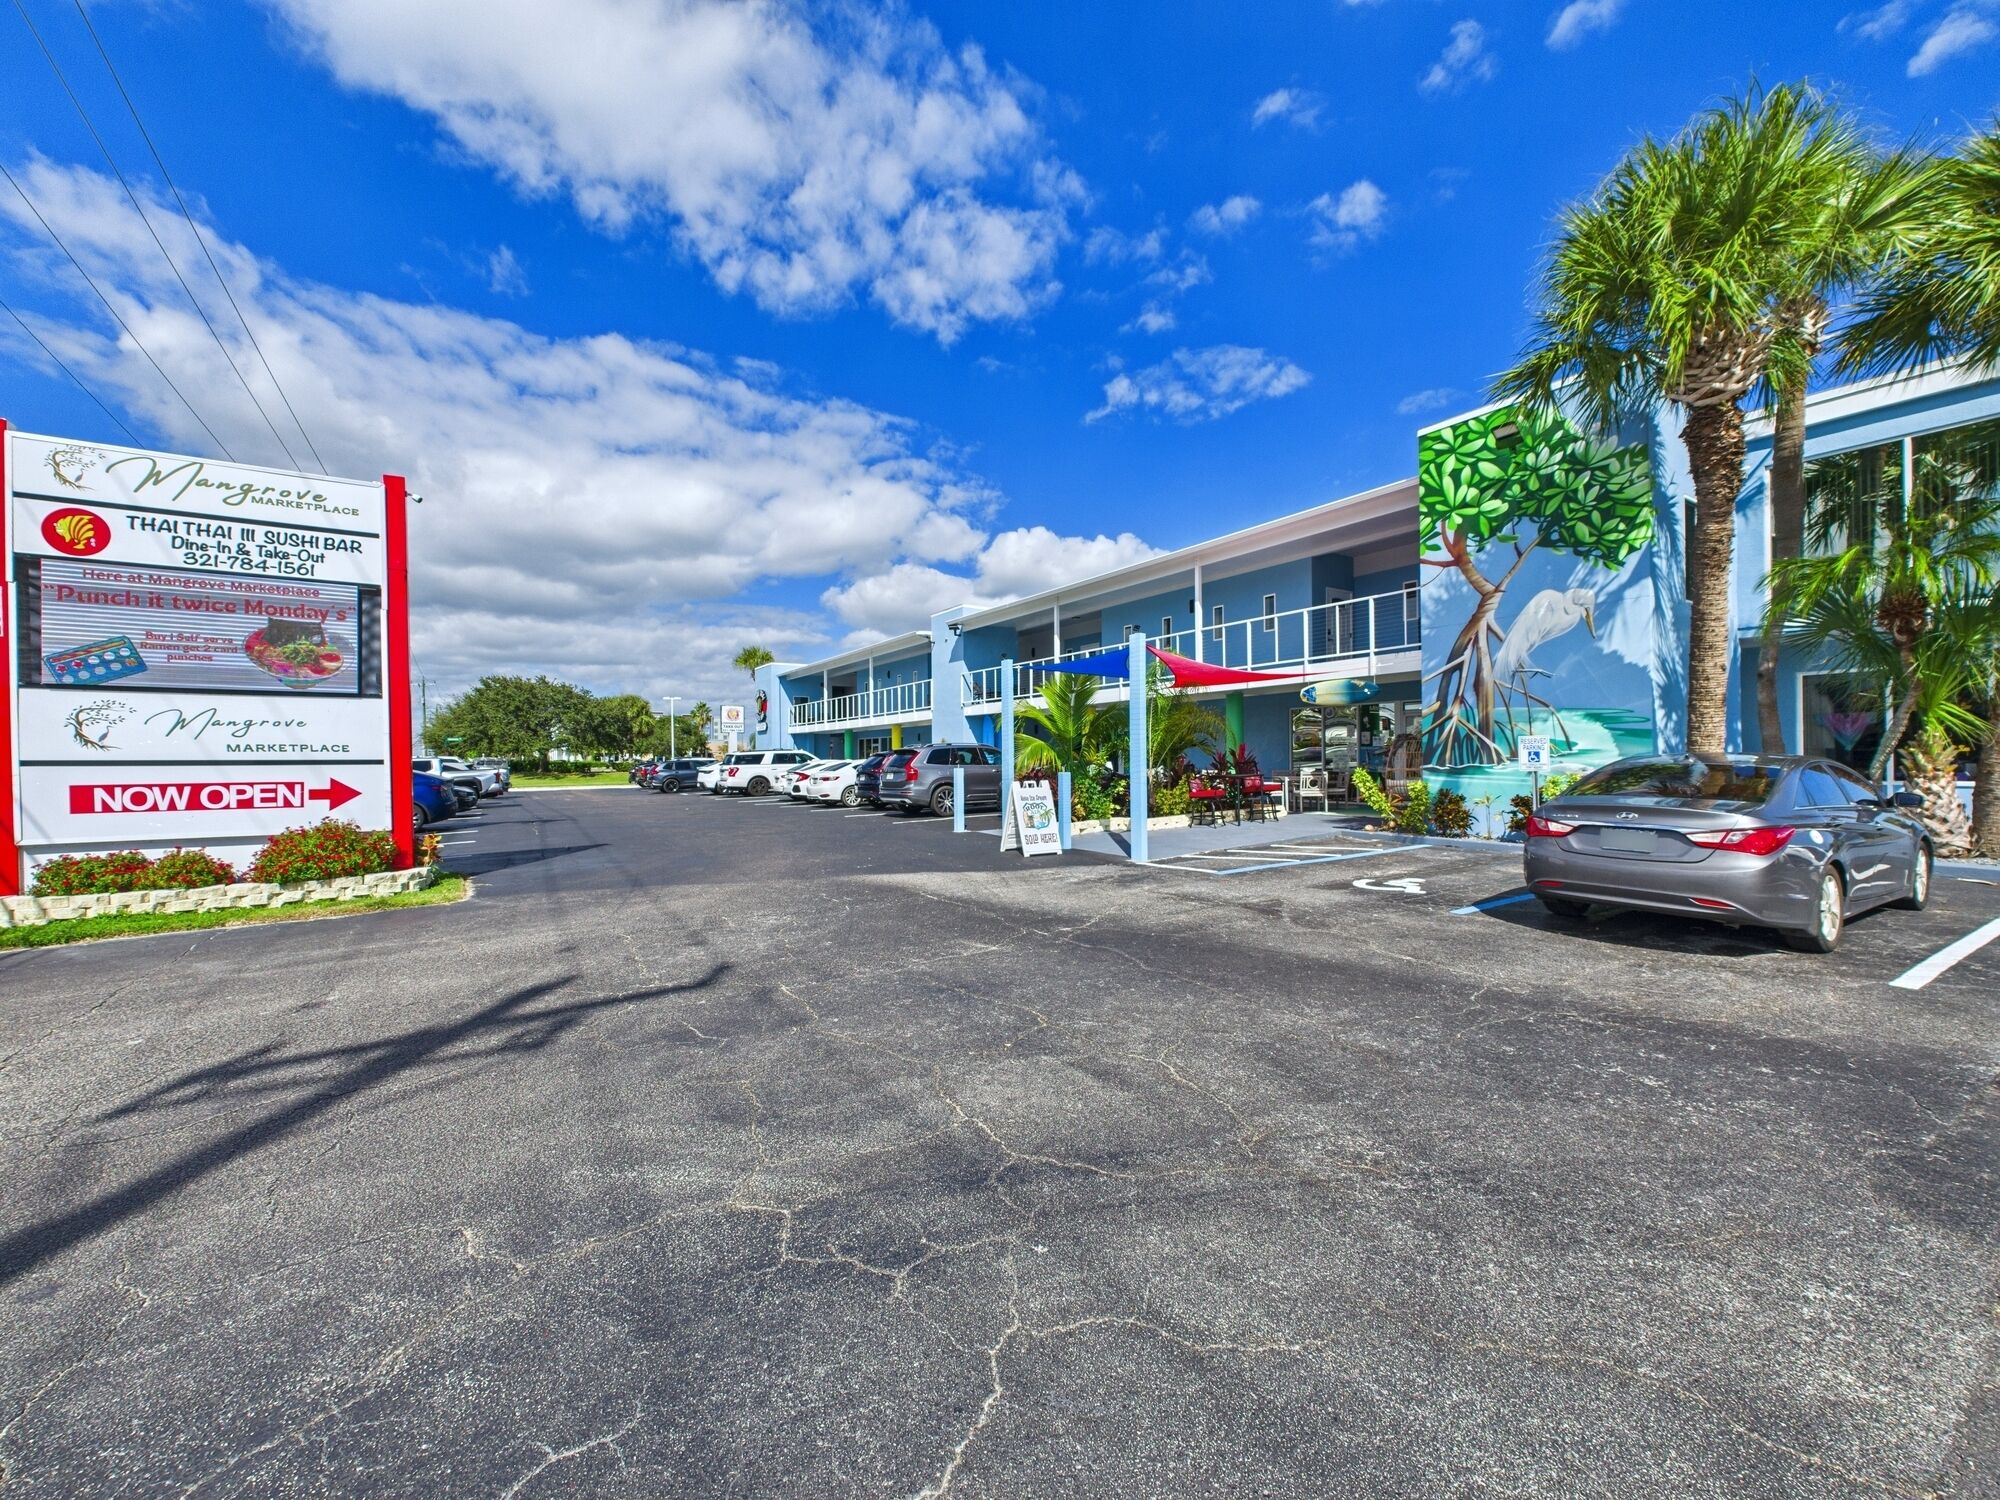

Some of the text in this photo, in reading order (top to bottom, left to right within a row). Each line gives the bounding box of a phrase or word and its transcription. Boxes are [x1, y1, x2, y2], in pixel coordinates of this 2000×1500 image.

[105, 457, 328, 506] Mangrove
[251, 496, 360, 517] MARKETPLACE
[126, 515, 179, 534] THAI
[183, 521, 232, 540] THAI
[264, 531, 319, 550] SUSHI
[324, 537, 363, 554] BAR
[172, 535, 325, 564] Dine-In & Take-Out
[183, 552, 315, 577] 321-784-1561
[82, 569, 320, 597] Here at Mangrove Marketplace
[147, 591, 164, 608] it
[171, 594, 237, 614] twice
[140, 642, 180, 650] Ramen
[182, 644, 201, 653] get
[144, 631, 167, 641] Buy
[166, 654, 213, 663] punches
[144, 708, 307, 740] Mangrove
[226, 744, 350, 753] MARKETPLACE
[94, 783, 302, 813] NOW OPEN
[1025, 803, 1044, 811] ROOT
[1024, 834, 1039, 844] SOLD
